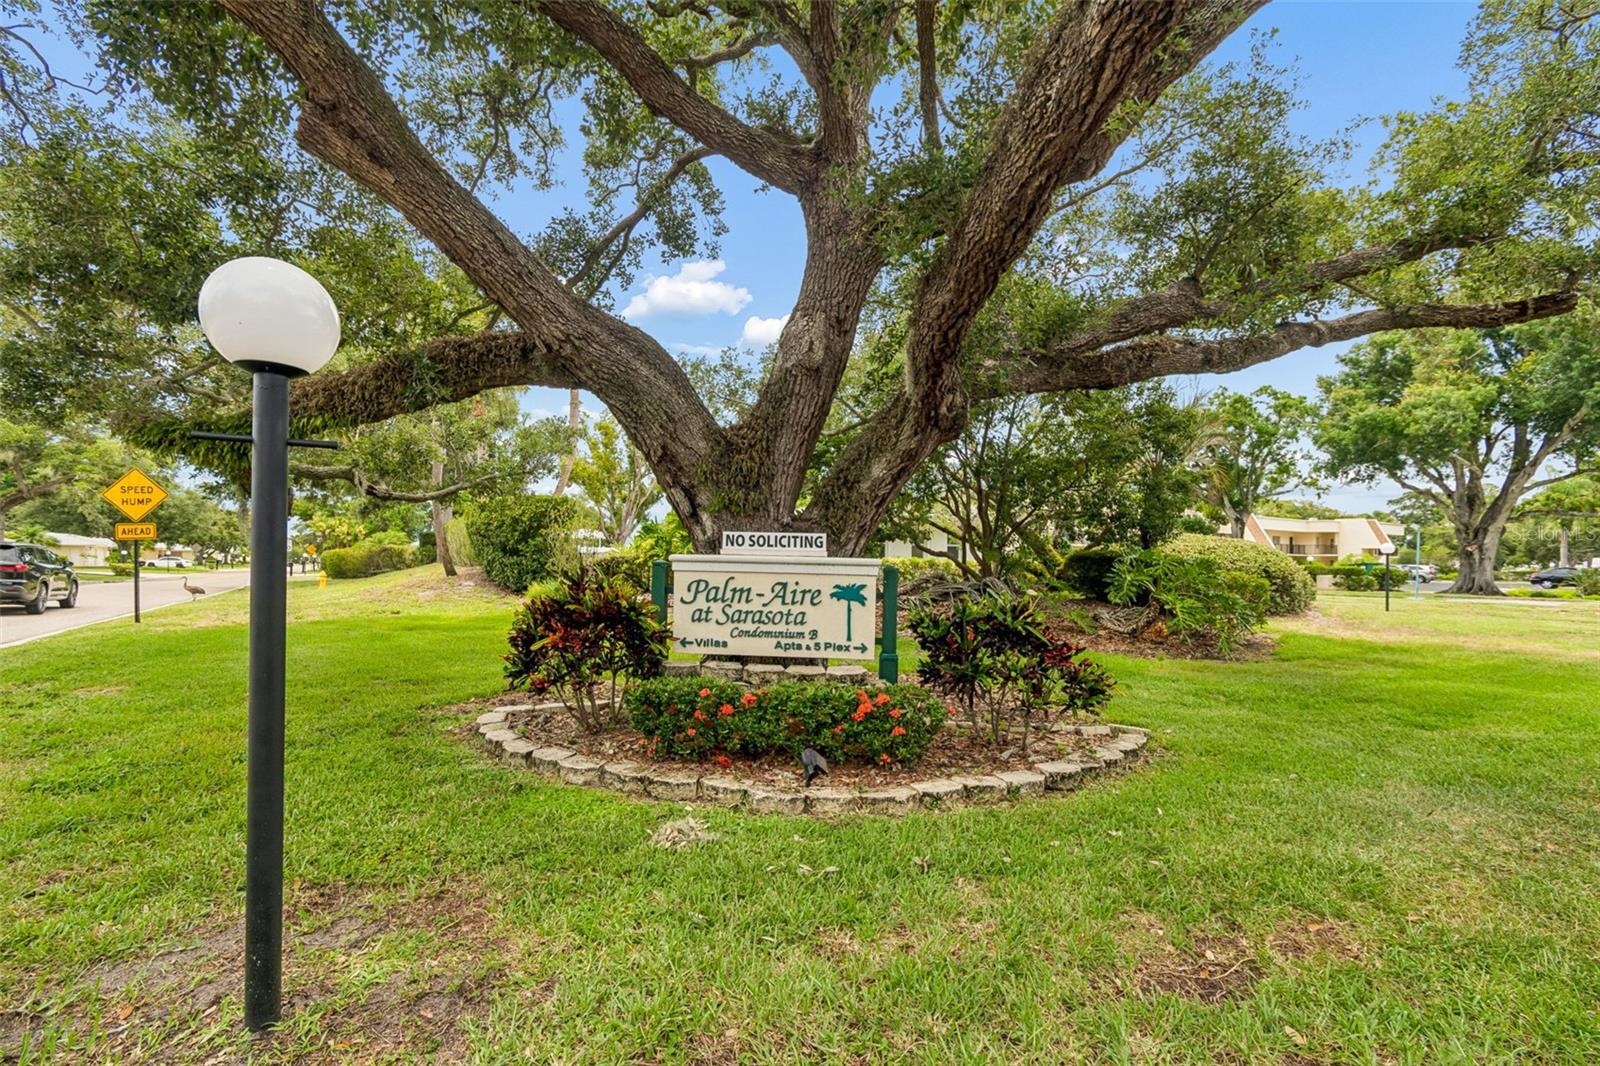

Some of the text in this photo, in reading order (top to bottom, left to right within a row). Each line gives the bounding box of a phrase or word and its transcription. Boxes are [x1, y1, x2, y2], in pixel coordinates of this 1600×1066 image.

[120, 486, 153, 494] SPEED
[121, 527, 151, 535] AHEAD
[725, 534, 824, 549] NO SOLICITING
[680, 576, 822, 607] Palm-Aire
[691, 604, 807, 626] at Sarasota
[730, 626, 818, 640] Condominium B
[694, 638, 728, 648] Villas
[774, 640, 802, 651] Apts
[813, 642, 821, 651] 5
[824, 642, 850, 653] Plex
